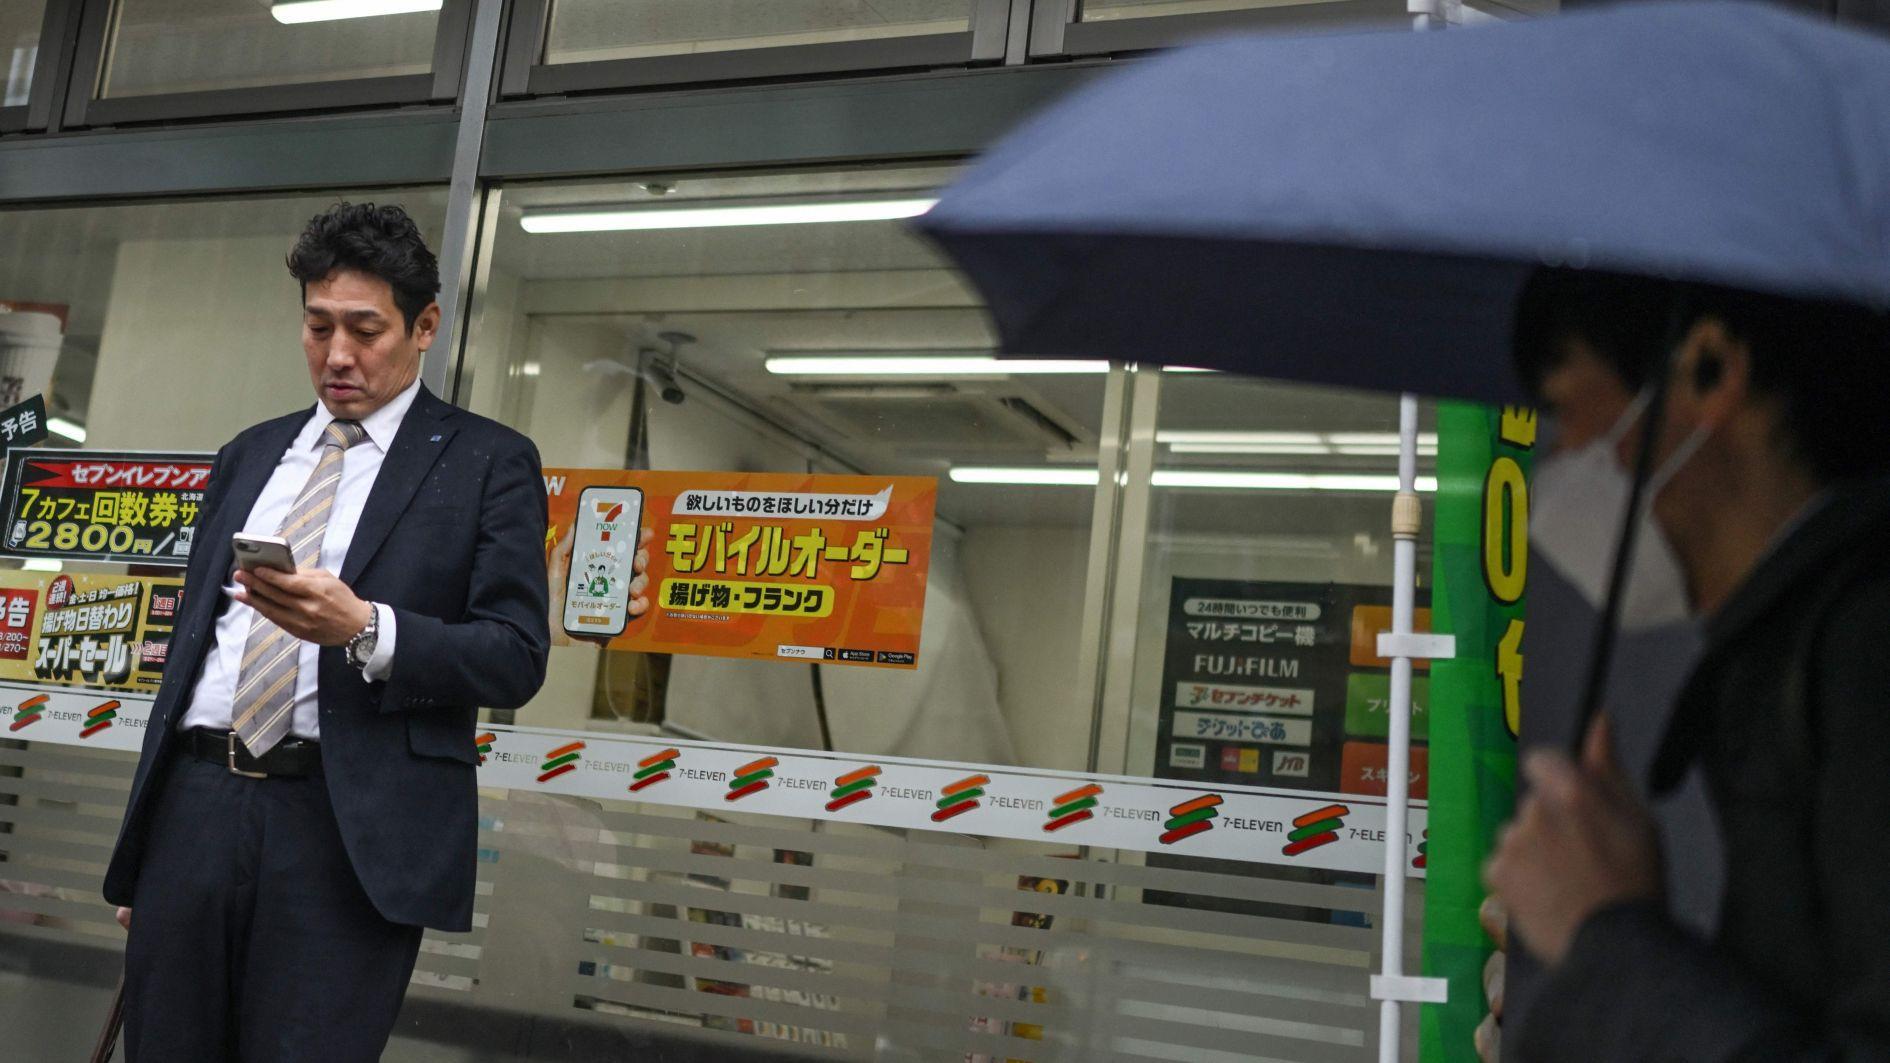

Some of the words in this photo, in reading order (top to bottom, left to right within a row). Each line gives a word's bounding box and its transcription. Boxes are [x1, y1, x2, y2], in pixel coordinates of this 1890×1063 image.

[1, 411, 37, 442] 予告
[686, 494, 874, 516] 欲しいものをほしい分だけ
[596, 522, 618, 531] now
[665, 521, 909, 580] モバイルオーダー
[571, 601, 621, 610] モバイルオーダー
[668, 582, 823, 613] 揚げ物・フランク
[1197, 602, 1307, 618] 24時間いつでも便利
[42, 602, 133, 634] 揚げ物日替わり
[1186, 621, 1316, 647] マルチコピー機
[34, 634, 128, 674] スーパーセール
[1193, 654, 1300, 678] FUJIFILM
[1211, 689, 1301, 708] セブンチケット
